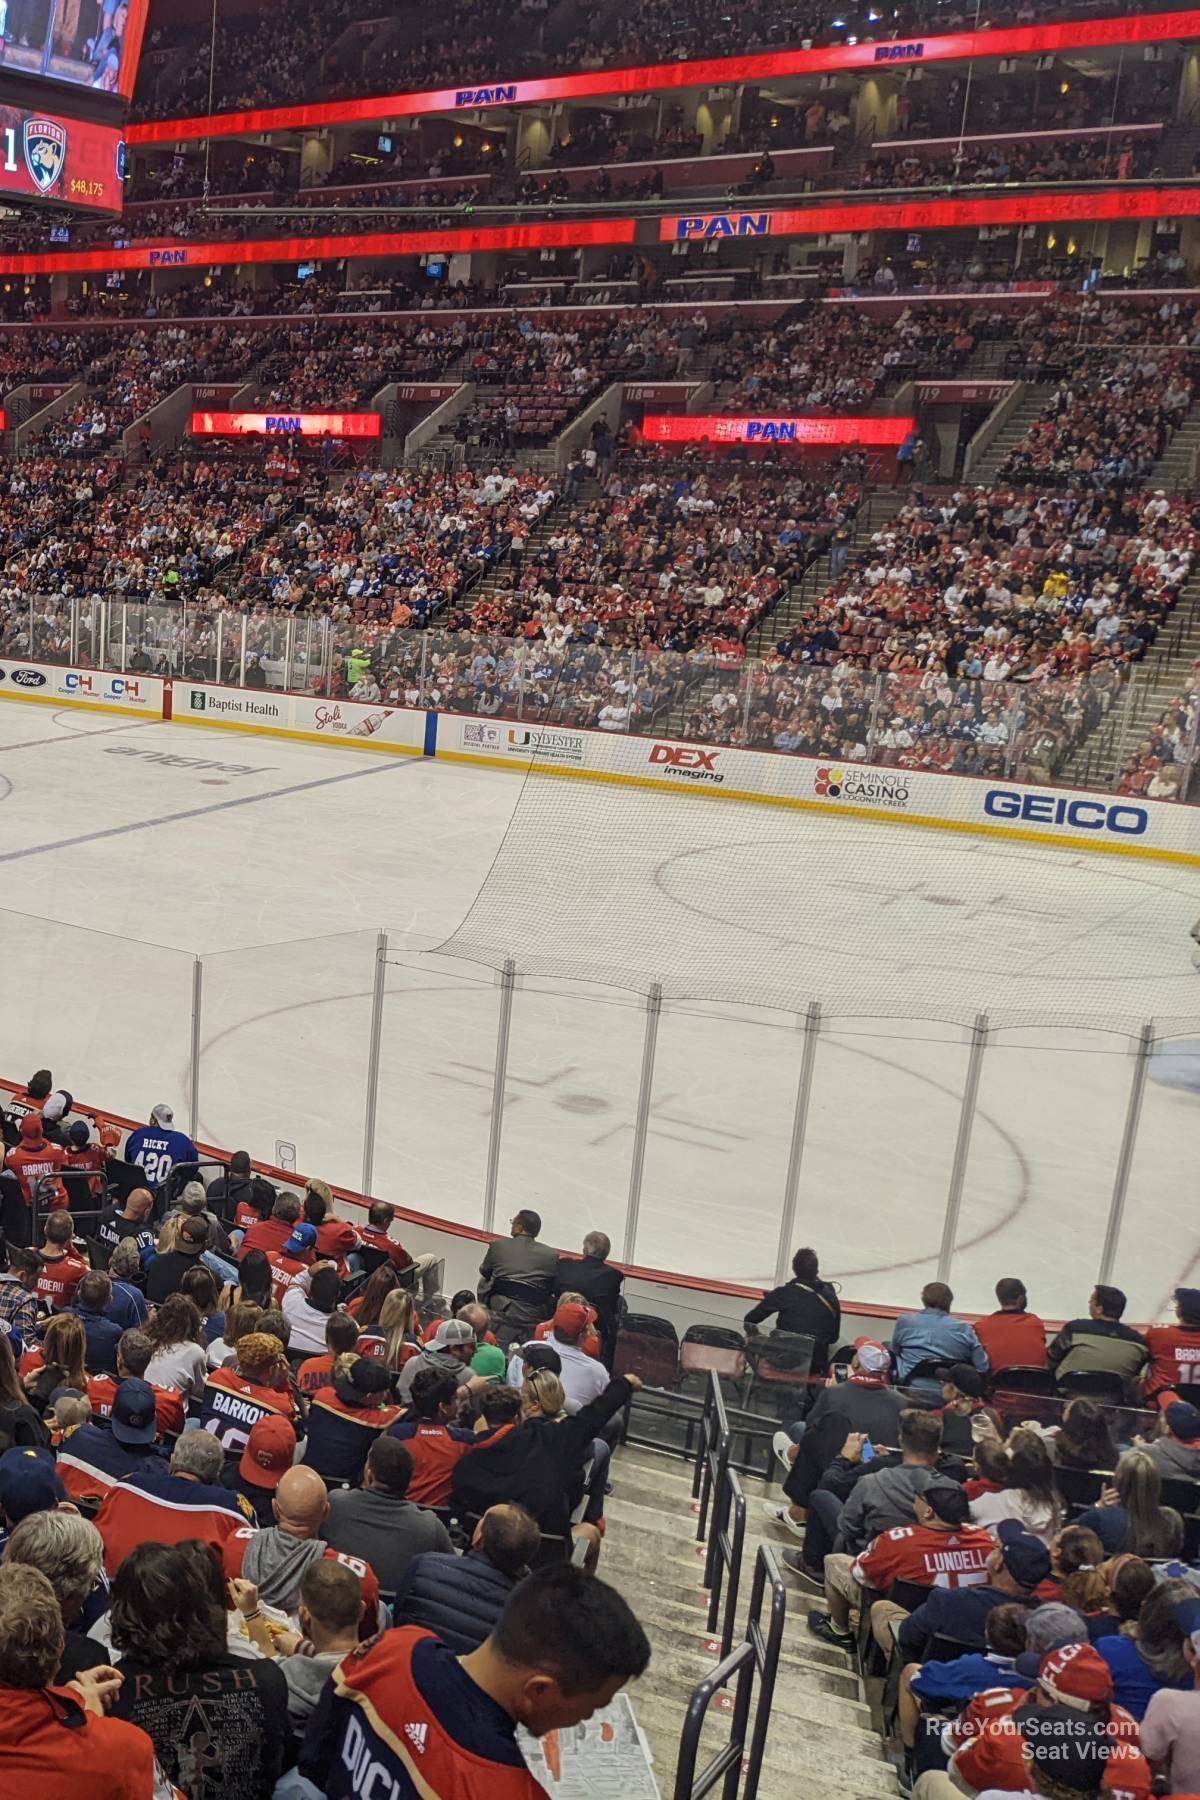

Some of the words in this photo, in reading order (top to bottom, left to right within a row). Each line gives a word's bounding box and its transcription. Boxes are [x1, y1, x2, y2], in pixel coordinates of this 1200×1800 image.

[874, 43, 924, 61] PAN
[455, 86, 517, 106] PAN
[29, 124, 61, 139] FLORIDA
[4, 129, 18, 172] 1
[70, 179, 104, 197] $48,175
[677, 214, 770, 239] PAN
[150, 250, 188, 264] PAN
[626, 388, 642, 400] 118
[919, 387, 941, 400] 119
[265, 417, 301, 433] PAN
[747, 422, 796, 441] PAN
[15, 670, 42, 687] Ford
[65, 673, 93, 692] CH
[58, 686, 75, 696] Cooper
[103, 692, 121, 701] Cooper
[111, 679, 139, 698] CH
[208, 696, 242, 713] Baptist
[245, 700, 280, 717] Health
[315, 704, 342, 731] Stoli
[531, 732, 583, 750] SYLVESTER
[648, 744, 721, 771] DEX
[664, 765, 724, 783] imaging
[845, 770, 912, 789] SEMINOLE
[844, 781, 910, 803] CASINO
[842, 795, 882, 806] COCONUT
[883, 798, 908, 809] CREEK
[984, 790, 1149, 836] GEICO
[142, 1138, 169, 1152] RICKY
[22, 1163, 54, 1176] BARKOV
[99, 1224, 120, 1245] CLARK
[924, 1548, 989, 1573] LUNDELL
[133, 1668, 260, 1700] RUSH
